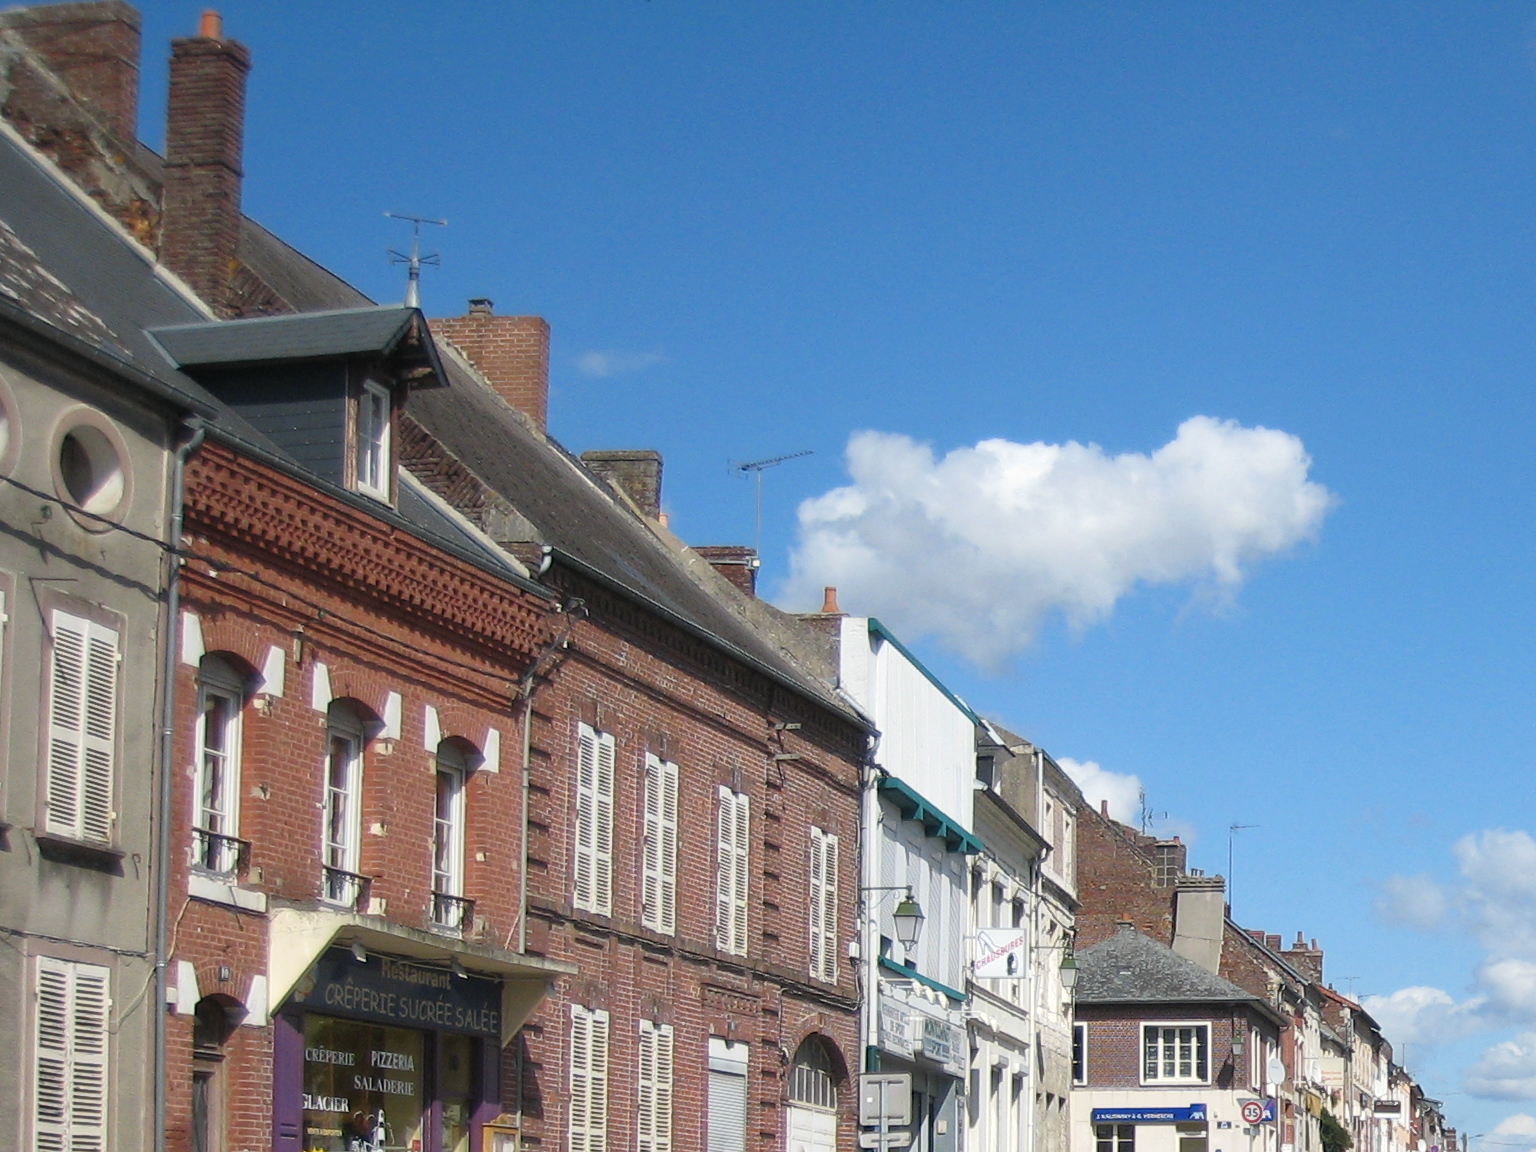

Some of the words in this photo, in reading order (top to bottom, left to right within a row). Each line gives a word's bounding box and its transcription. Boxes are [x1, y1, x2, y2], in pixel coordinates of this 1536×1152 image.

[381, 959, 452, 990] Restaurant
[325, 977, 396, 1017] CRÊPERIE
[399, 995, 452, 1026] SUCRÉE
[455, 1002, 498, 1033] SALÉE
[305, 1045, 355, 1066] CRÊPERIE
[371, 1050, 415, 1072] PIZZERIA
[354, 1074, 414, 1096] SALADERIE
[1246, 1108, 1258, 1117] 35
